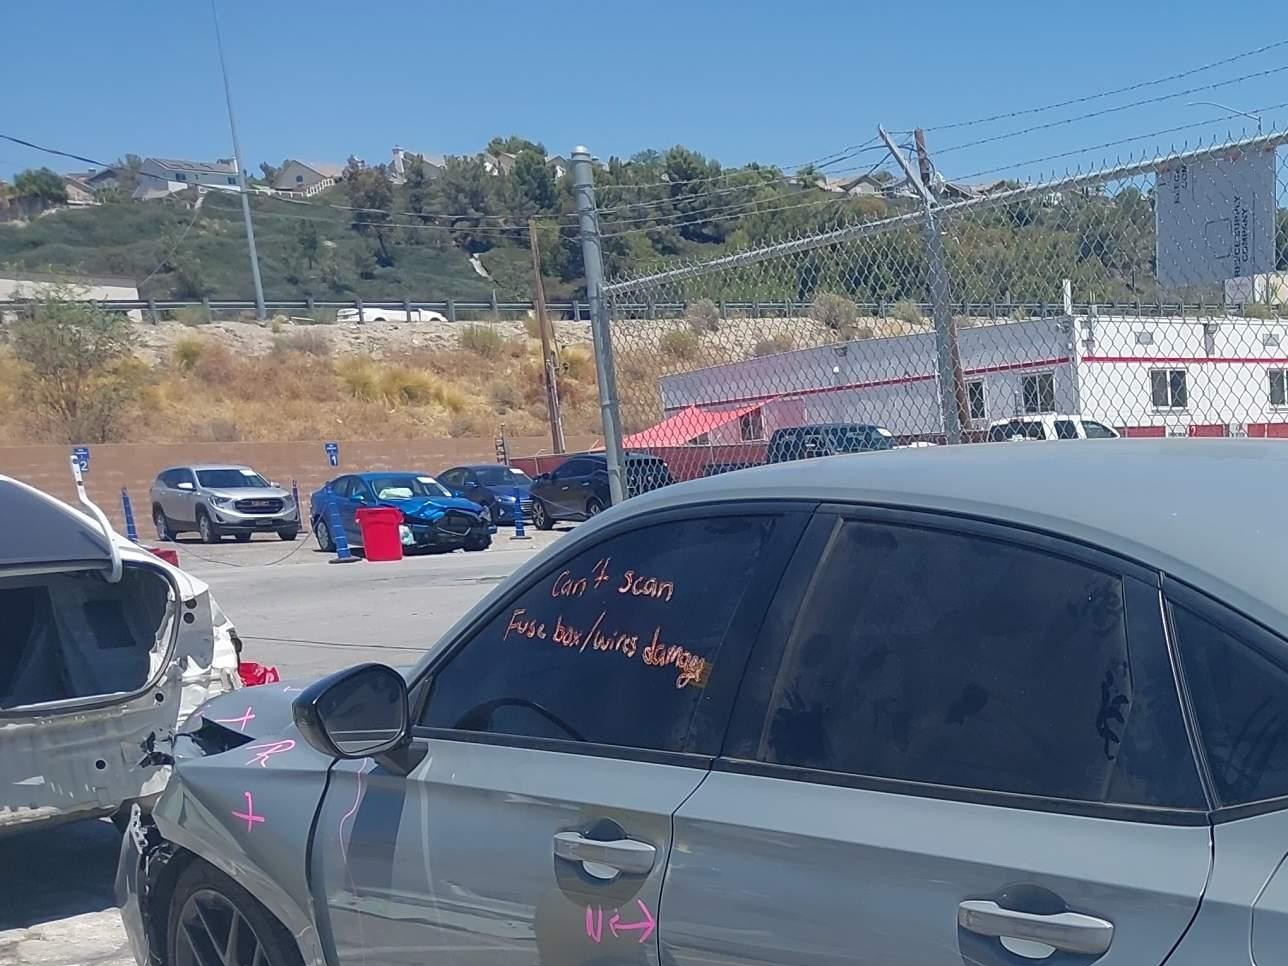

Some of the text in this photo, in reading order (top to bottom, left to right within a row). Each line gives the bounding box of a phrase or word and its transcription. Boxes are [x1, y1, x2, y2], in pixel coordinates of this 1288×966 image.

[80, 460, 88, 471] 2
[617, 569, 675, 601] scan
[503, 607, 547, 641] Fuse
